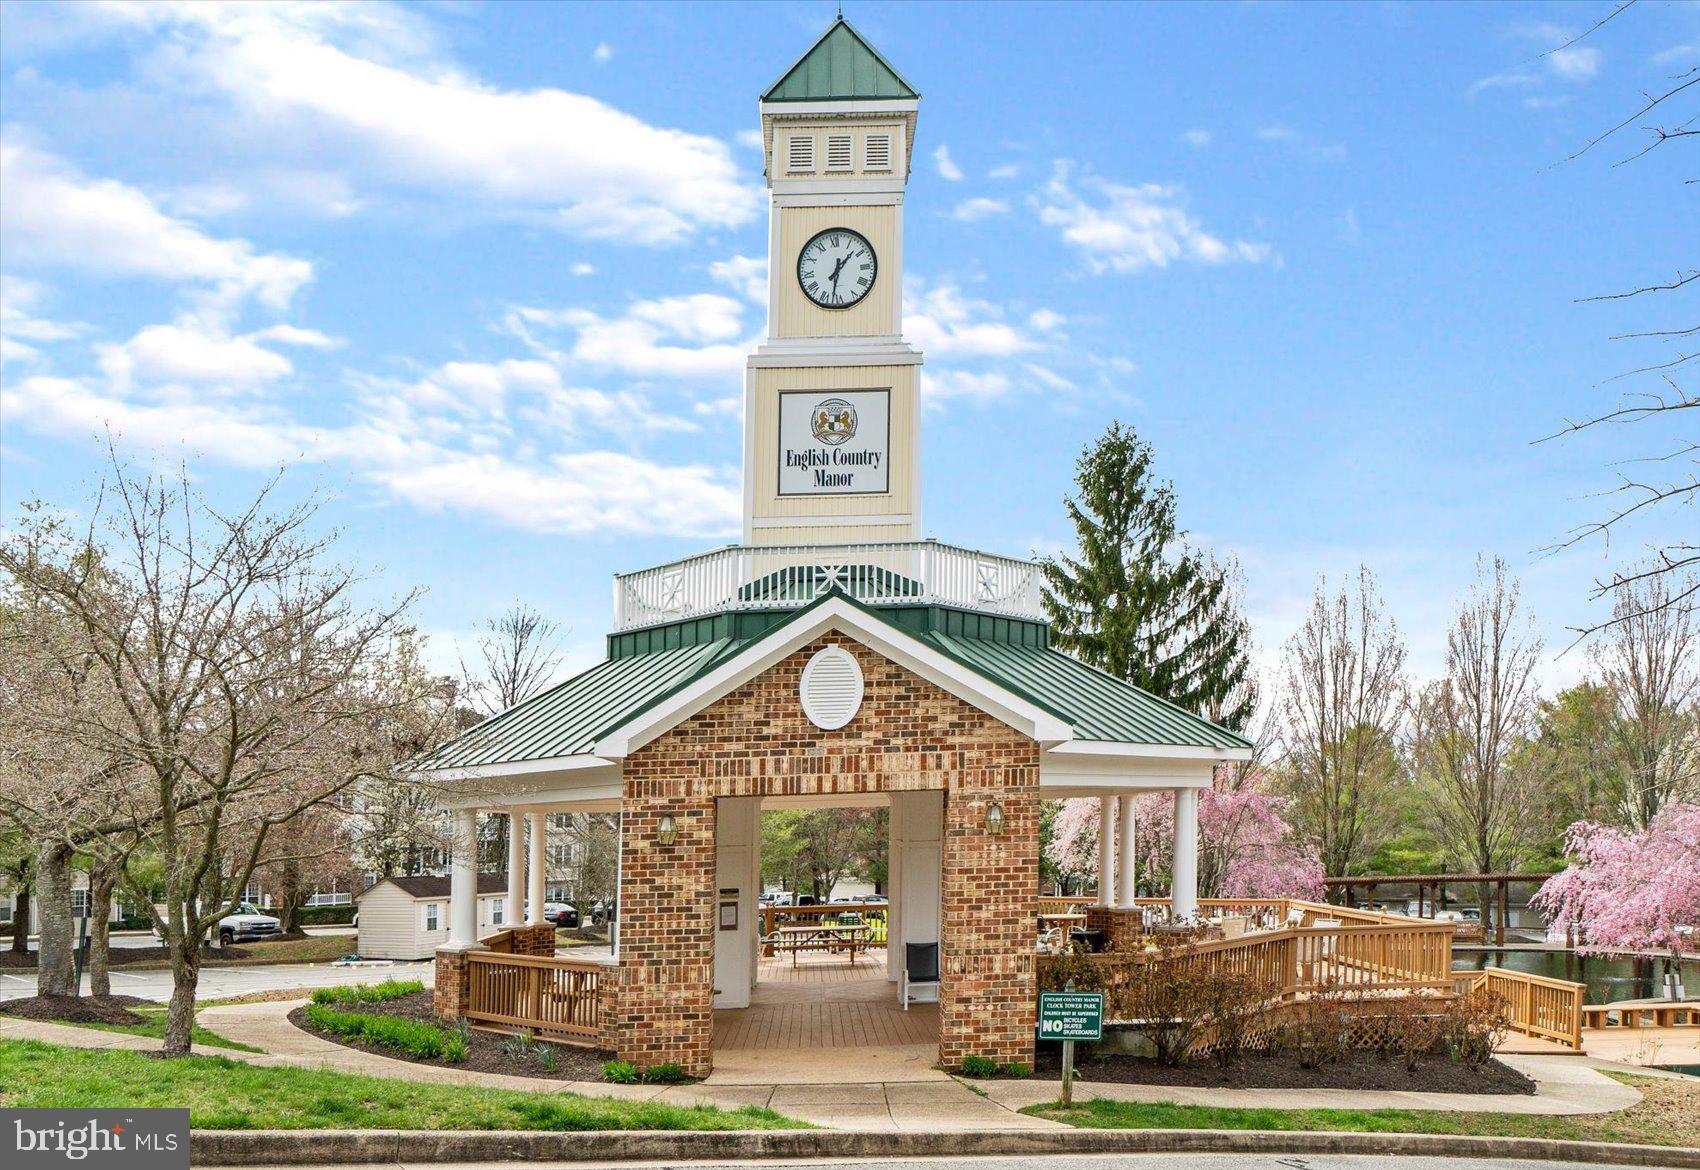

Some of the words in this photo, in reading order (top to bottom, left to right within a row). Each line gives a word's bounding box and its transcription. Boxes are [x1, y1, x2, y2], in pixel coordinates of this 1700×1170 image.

[786, 448, 829, 472] English
[833, 447, 882, 469] Country
[814, 469, 854, 487] Manor
[1042, 1020, 1063, 1032] NO
